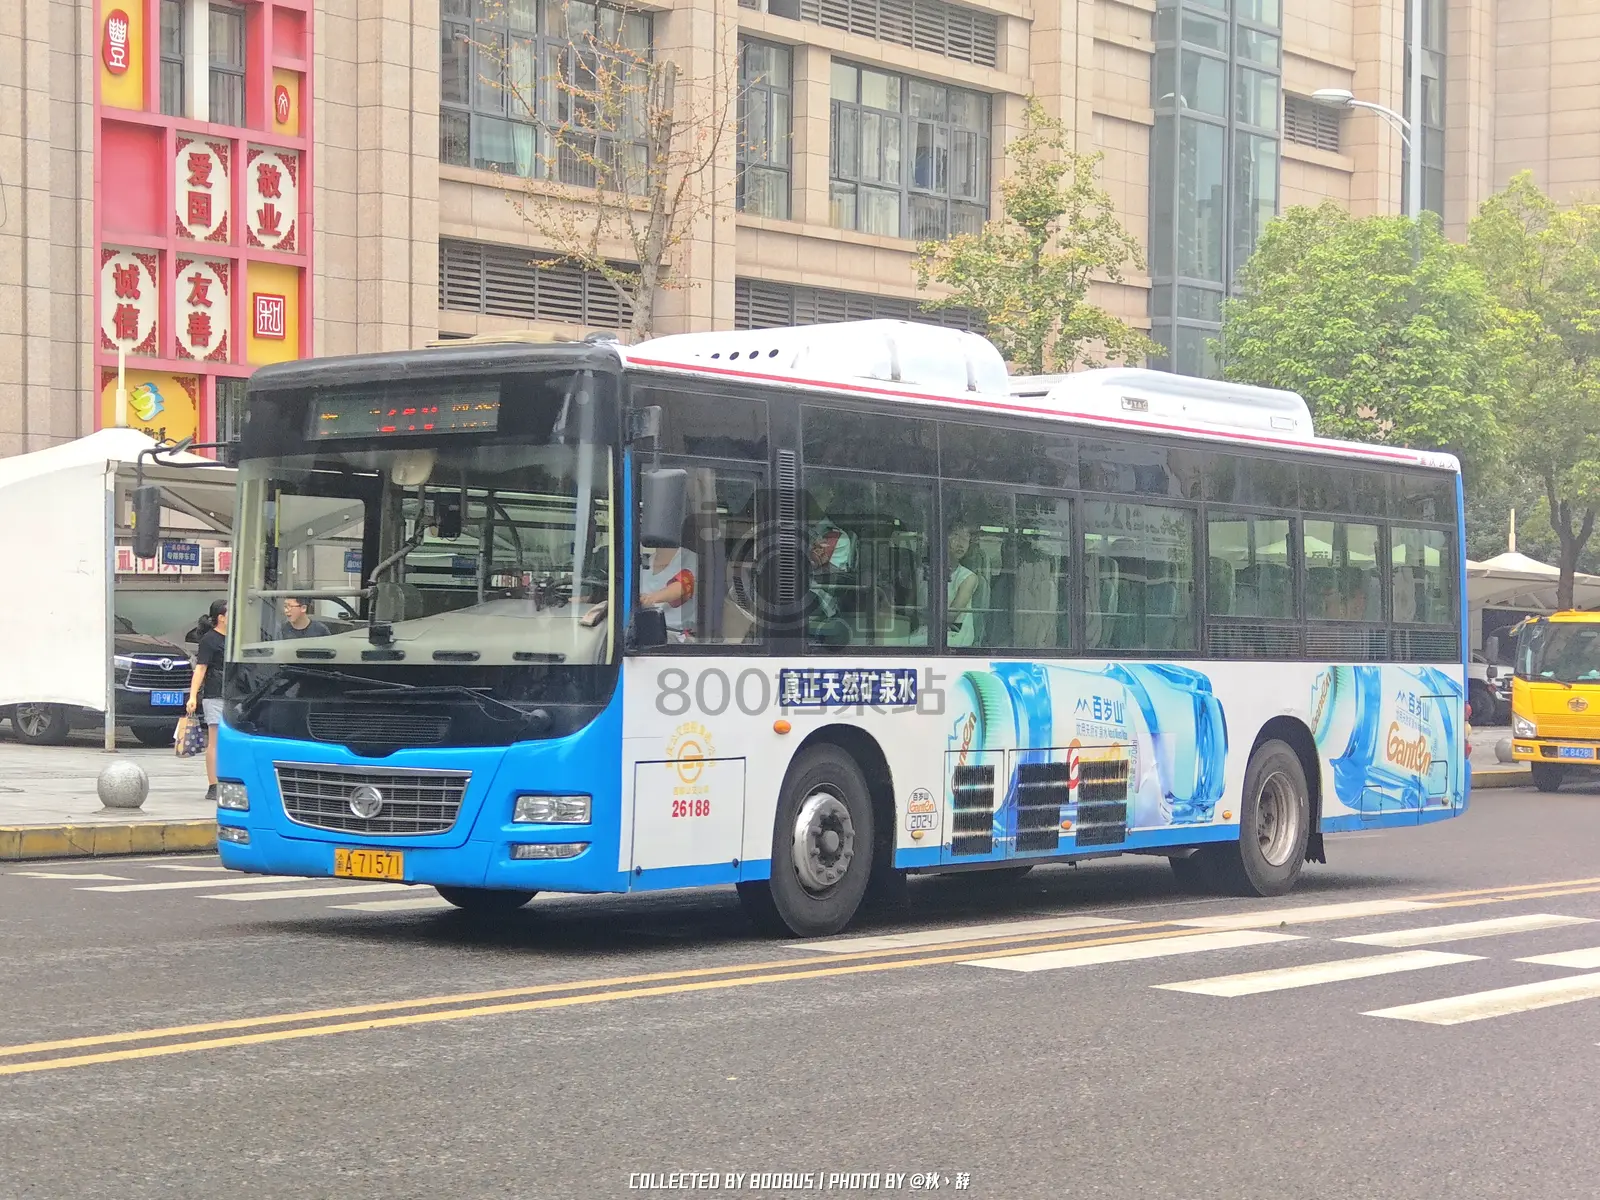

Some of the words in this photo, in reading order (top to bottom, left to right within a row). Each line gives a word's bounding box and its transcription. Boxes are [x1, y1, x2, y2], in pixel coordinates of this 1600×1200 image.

[187, 152, 213, 228] 爱国
[257, 163, 282, 237] 敬业
[112, 263, 141, 341] 诚信
[186, 272, 213, 347] 友善
[781, 671, 916, 704] 真正天然矿泉水
[1092, 695, 1125, 724] 百岁山
[1408, 691, 1429, 722] 百岁山
[1387, 721, 1432, 776] Ganten
[672, 799, 710, 818] 26188
[911, 814, 933, 829] 2024
